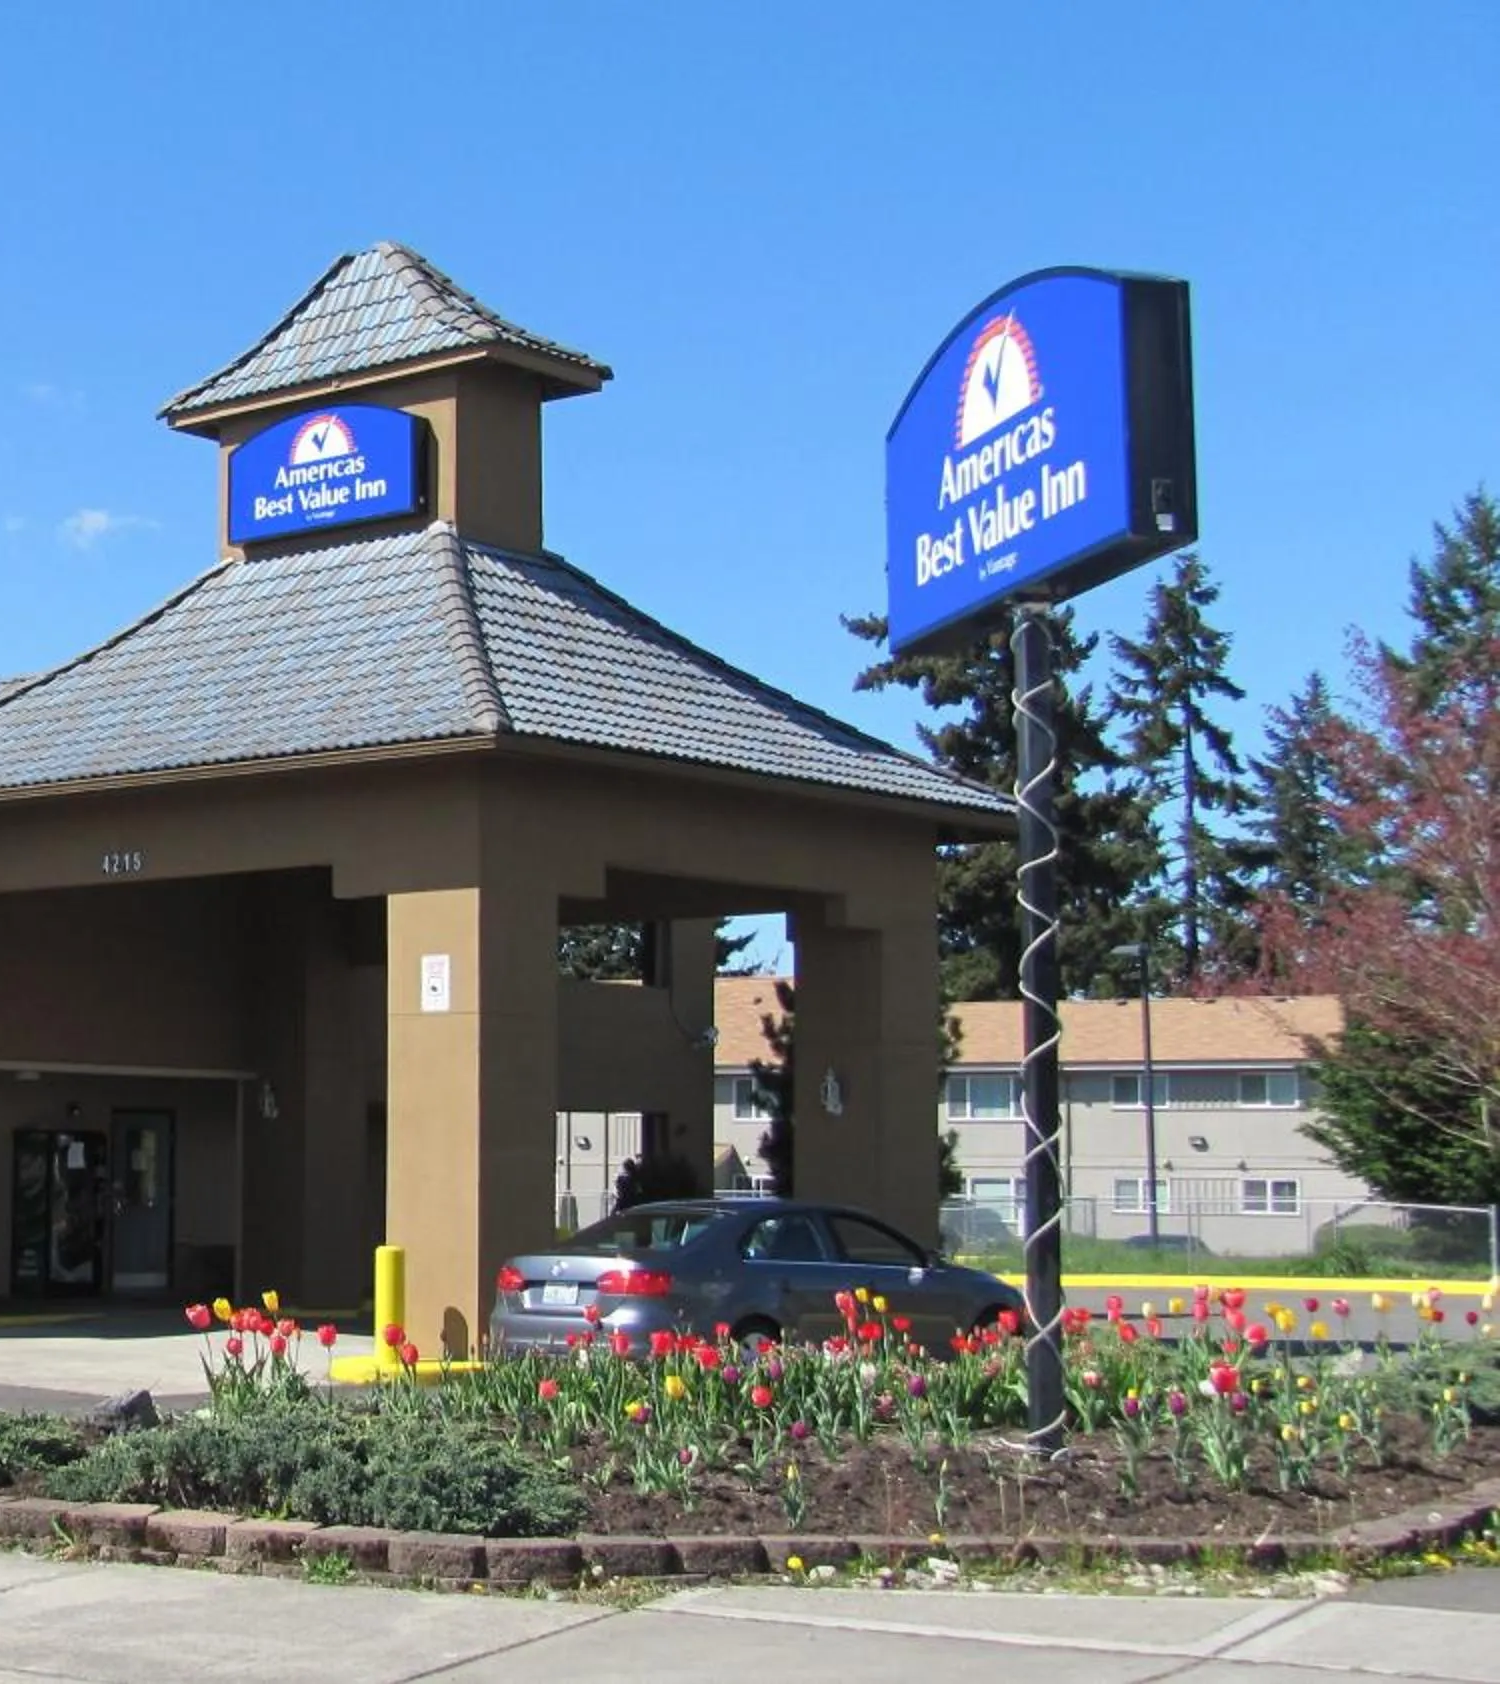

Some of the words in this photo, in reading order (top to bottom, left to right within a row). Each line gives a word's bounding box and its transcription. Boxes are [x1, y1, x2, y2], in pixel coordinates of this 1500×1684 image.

[275, 456, 364, 490] Americas
[939, 407, 1055, 511] Americas
[254, 494, 293, 521] Best
[298, 483, 349, 511] Value
[355, 478, 387, 500] Inn
[916, 517, 964, 586] Best
[968, 484, 1035, 556] Value
[1041, 461, 1086, 519] Inn
[102, 852, 141, 873] 4215
